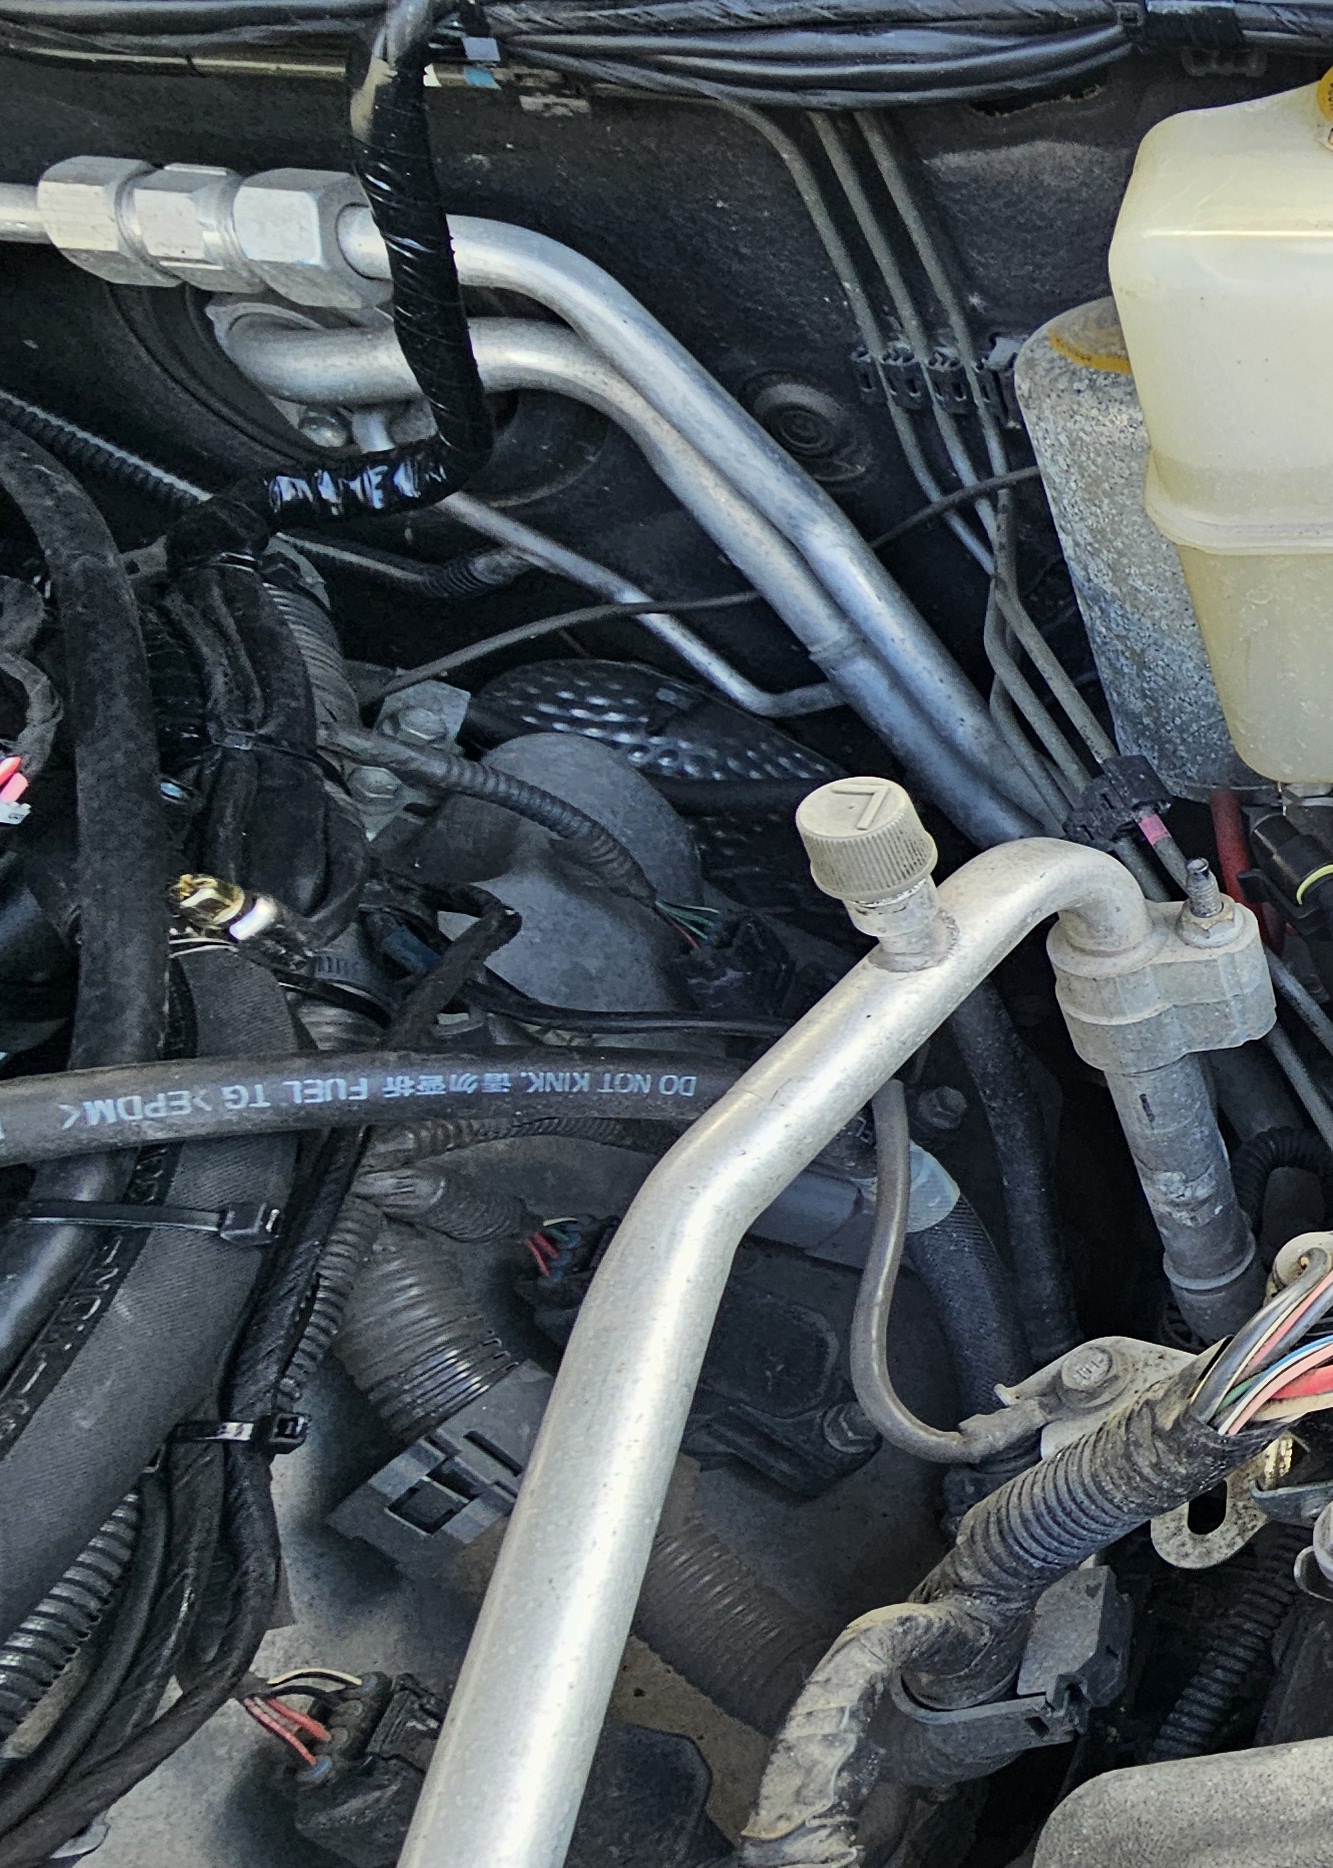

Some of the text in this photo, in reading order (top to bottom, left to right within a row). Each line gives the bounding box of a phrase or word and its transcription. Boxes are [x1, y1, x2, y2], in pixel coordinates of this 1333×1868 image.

[282, 1076, 369, 1105] FUEL
[597, 1072, 651, 1094] NOT
[658, 1074, 698, 1097] DO
[220, 1083, 272, 1110] TG
